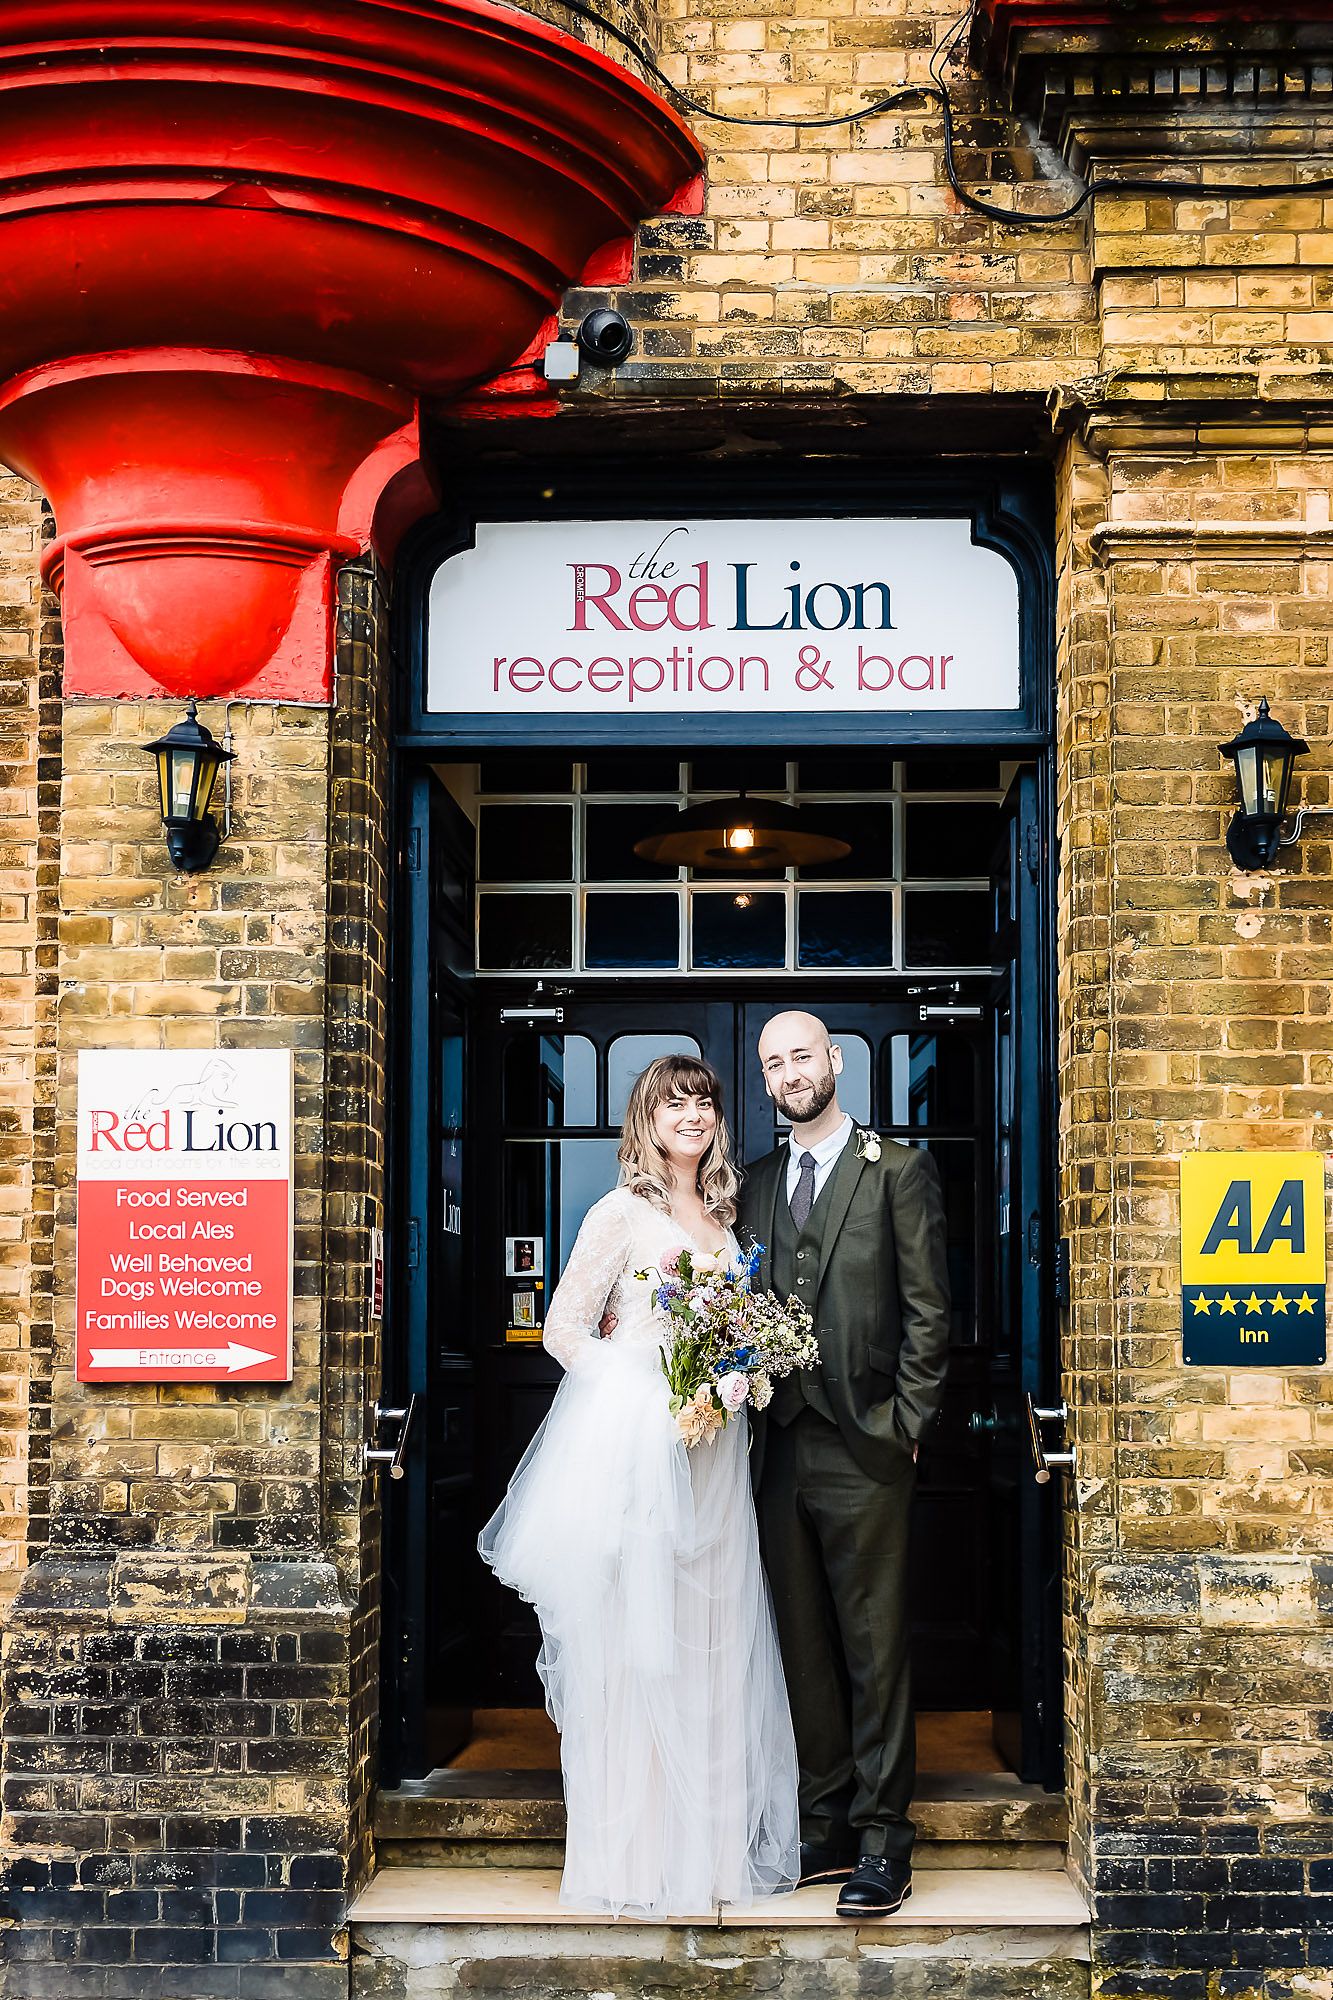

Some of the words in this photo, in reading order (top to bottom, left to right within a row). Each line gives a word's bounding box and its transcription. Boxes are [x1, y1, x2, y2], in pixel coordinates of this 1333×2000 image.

[628, 527, 690, 580] the
[576, 565, 584, 602] CROMER
[566, 561, 716, 632] Red
[727, 561, 898, 631] Lion
[493, 646, 769, 702] reception
[795, 645, 834, 692] &
[858, 646, 954, 692] bar
[87, 1109, 174, 1152] Red
[181, 1109, 280, 1152] Lion
[116, 1188, 171, 1207] Food
[176, 1187, 248, 1207] Served
[1199, 1179, 1306, 1255] AA
[129, 1221, 186, 1240] Local
[191, 1221, 234, 1240] Ales
[109, 1253, 153, 1273] Well
[159, 1253, 252, 1273] Behaved
[101, 1278, 155, 1301] Dogs
[159, 1278, 262, 1297] Welcome
[85, 1311, 170, 1330] Families
[174, 1311, 277, 1330] Welcome
[1239, 1327, 1269, 1343] Inn
[139, 1351, 216, 1365] Entrance
